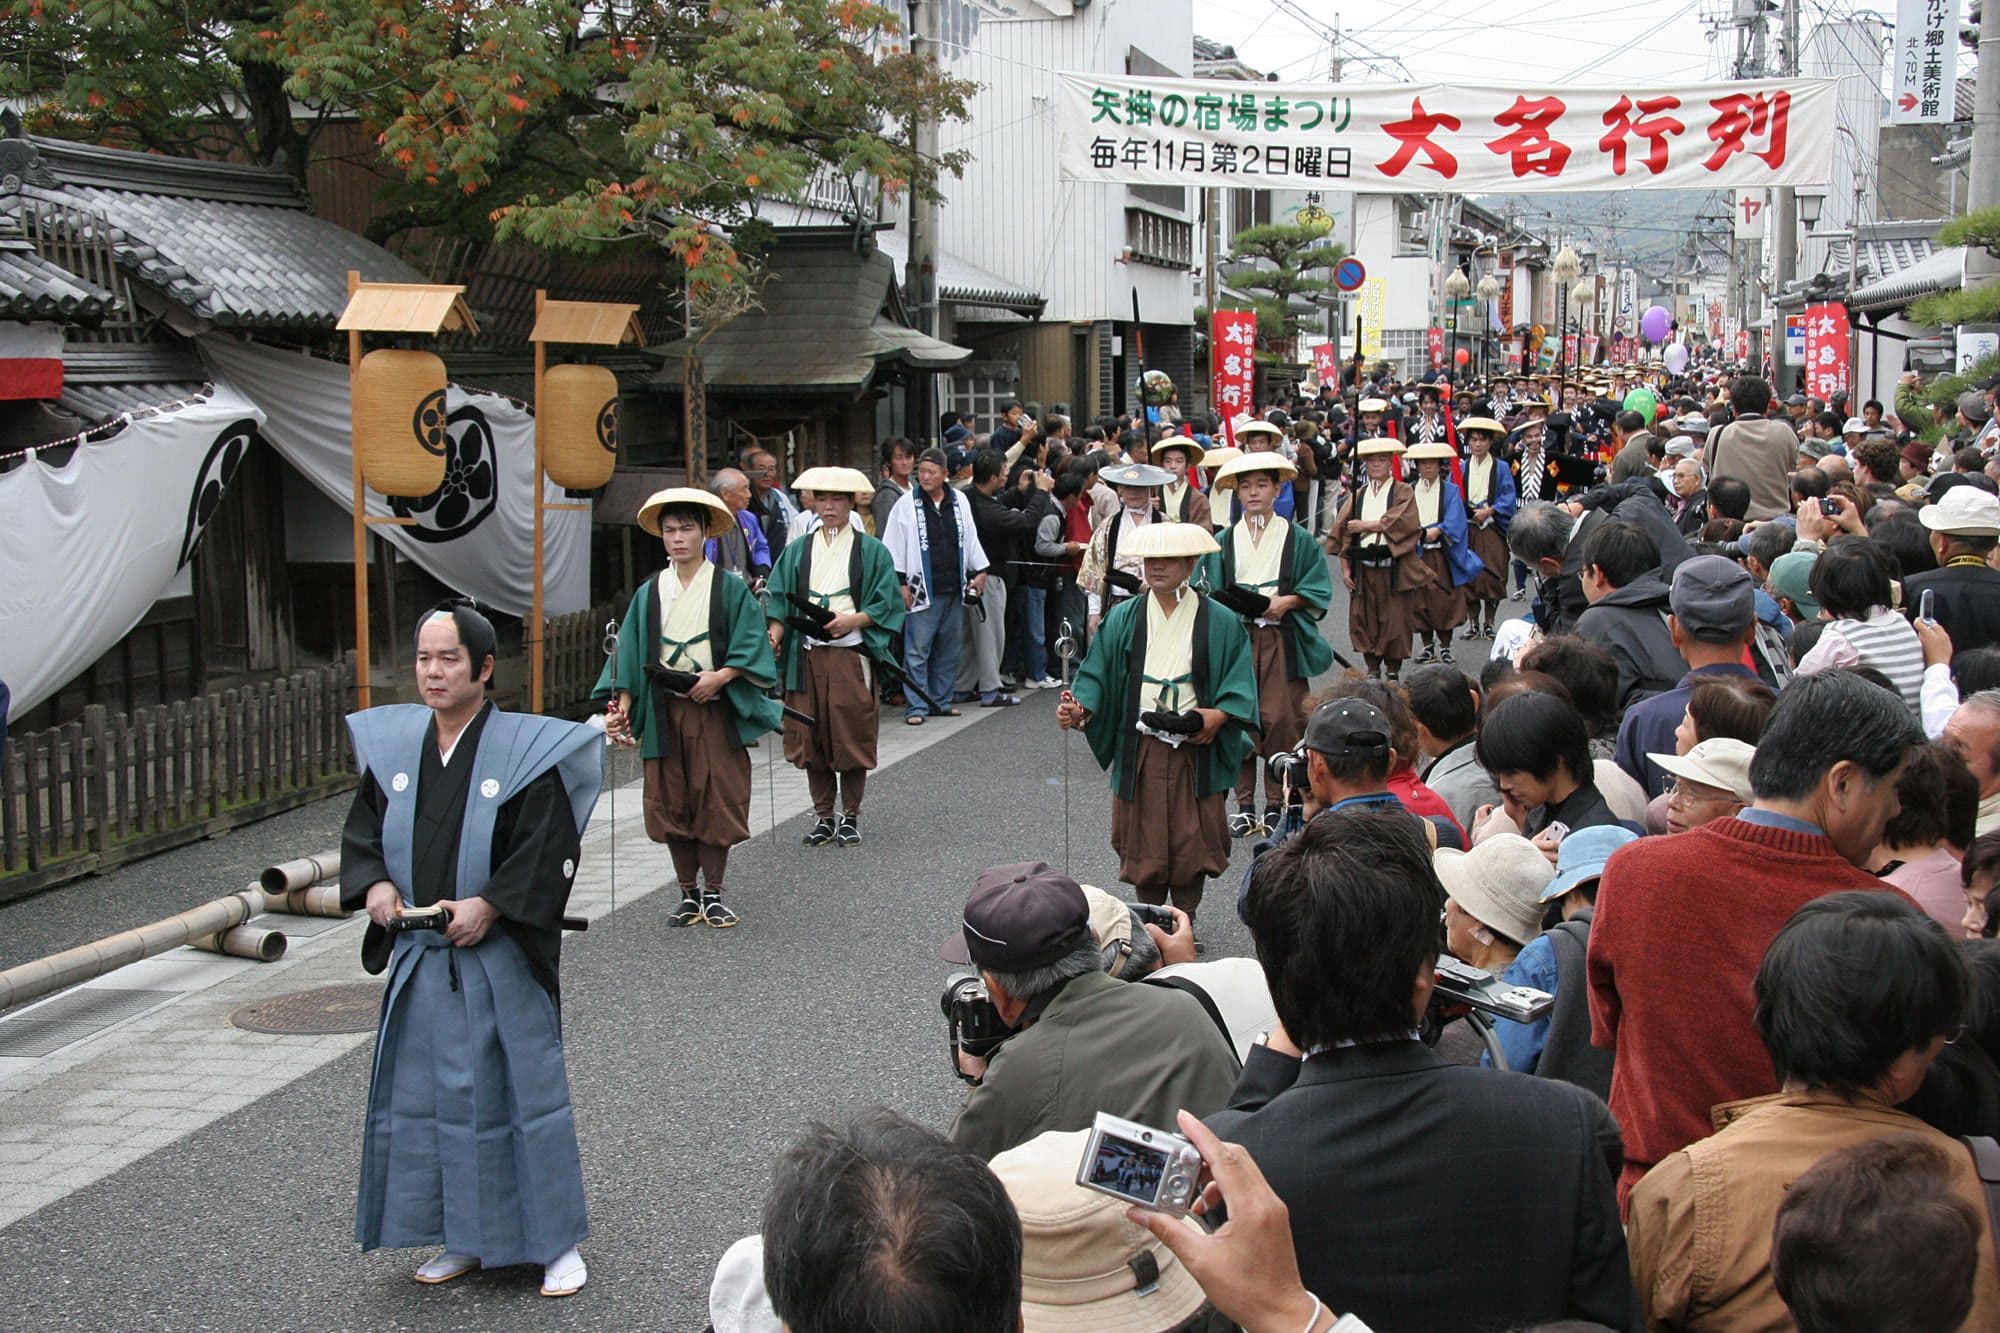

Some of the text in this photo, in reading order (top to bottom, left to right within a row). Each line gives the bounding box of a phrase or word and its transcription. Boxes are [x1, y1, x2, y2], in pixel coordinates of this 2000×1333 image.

[1091, 86, 1351, 133] 矢掛の宿場まつり
[1090, 135, 1351, 178] 毎年11月第2日曜日
[1374, 90, 1791, 179] 大名行列
